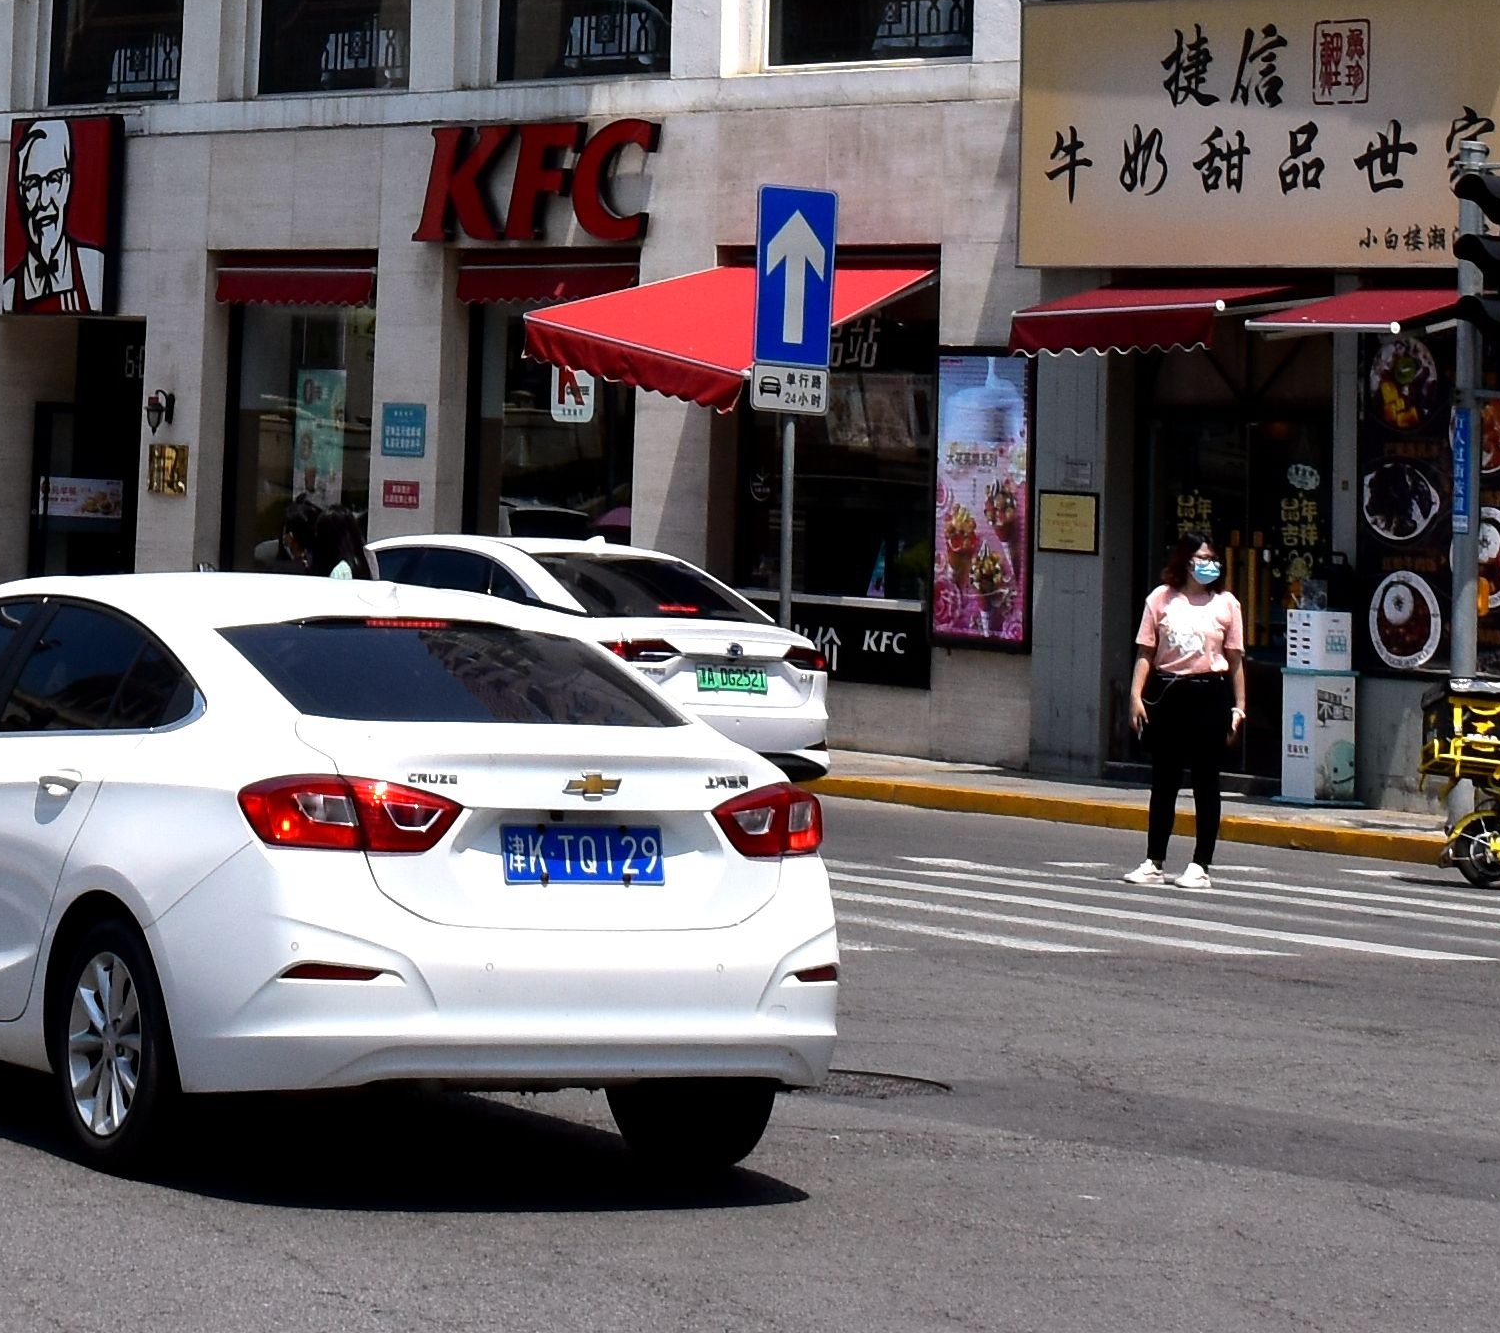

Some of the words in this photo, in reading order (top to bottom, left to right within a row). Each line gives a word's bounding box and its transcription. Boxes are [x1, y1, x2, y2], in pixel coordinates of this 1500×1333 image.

[1161, 23, 1288, 108] 捷信
[413, 118, 662, 243] KFC
[1359, 224, 1490, 251] 小白楼潮
[786, 372, 823, 390] 单行路
[784, 393, 822, 408] 24小时
[862, 629, 907, 654] KFC
[407, 773, 458, 785] CRUZE
